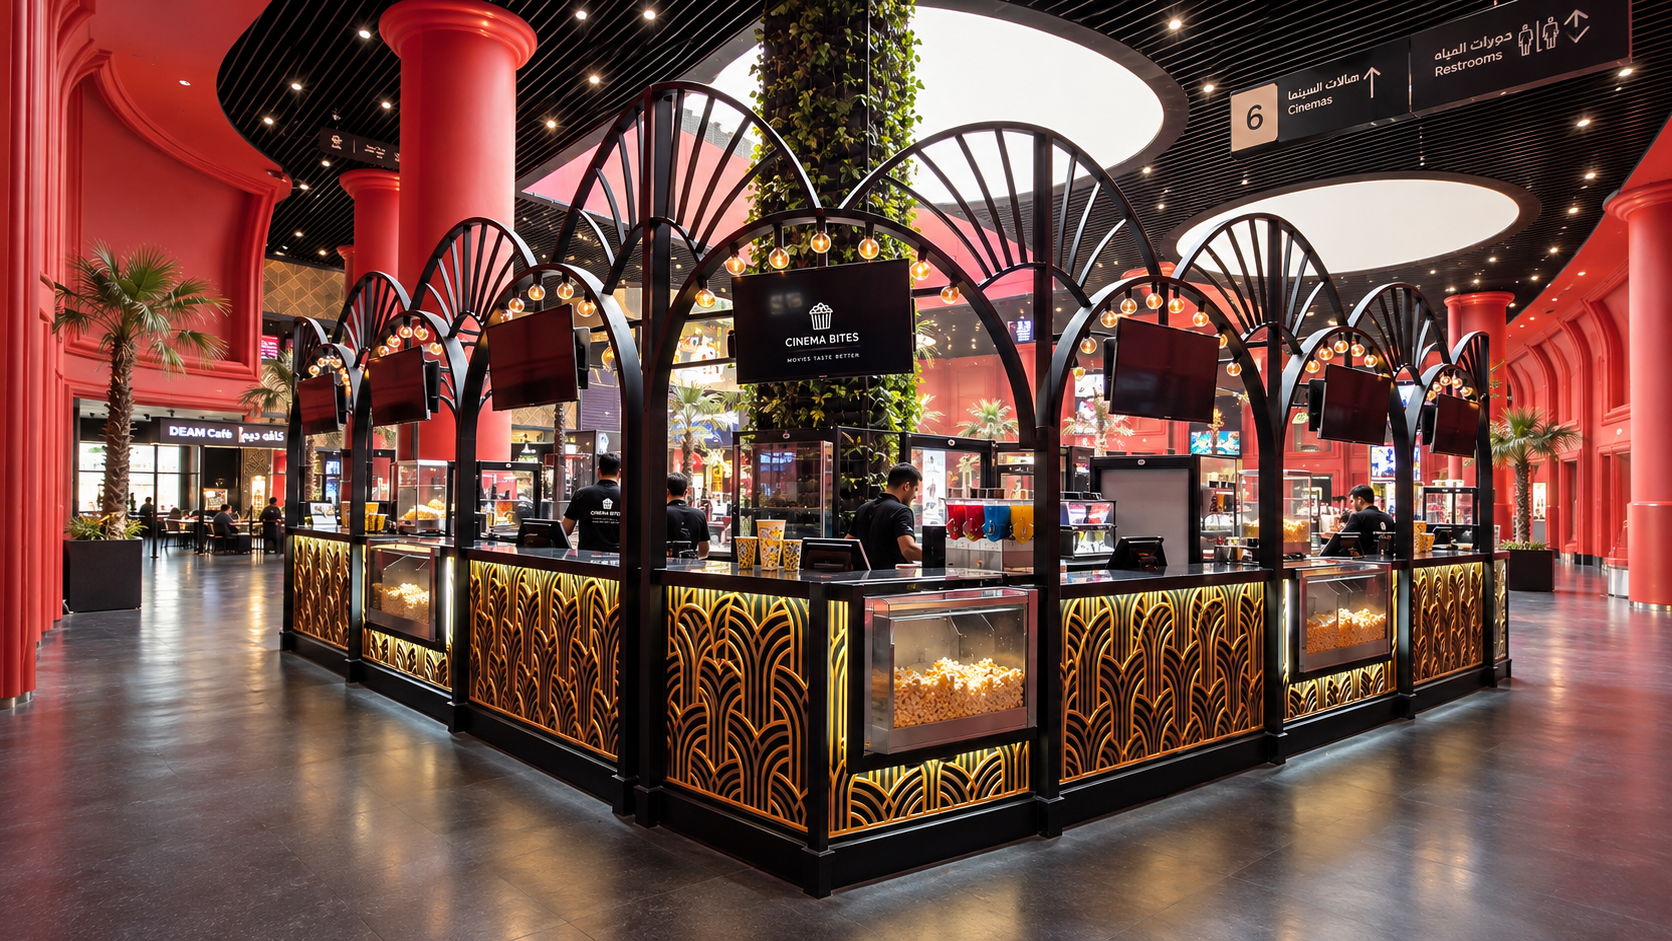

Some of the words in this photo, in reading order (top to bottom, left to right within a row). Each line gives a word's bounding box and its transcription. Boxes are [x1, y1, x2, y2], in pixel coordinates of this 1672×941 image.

[1470, 32, 1513, 51] دورات
[1434, 42, 1467, 61] المياه
[1435, 51, 1503, 77] Restrooms
[1288, 82, 1323, 100] السينما
[1288, 96, 1333, 115] Cinemas
[1246, 104, 1264, 130] 6
[785, 335, 826, 347] CINEMA
[829, 332, 860, 344] BITES
[169, 425, 206, 438] DEAM
[207, 428, 233, 439] Café
